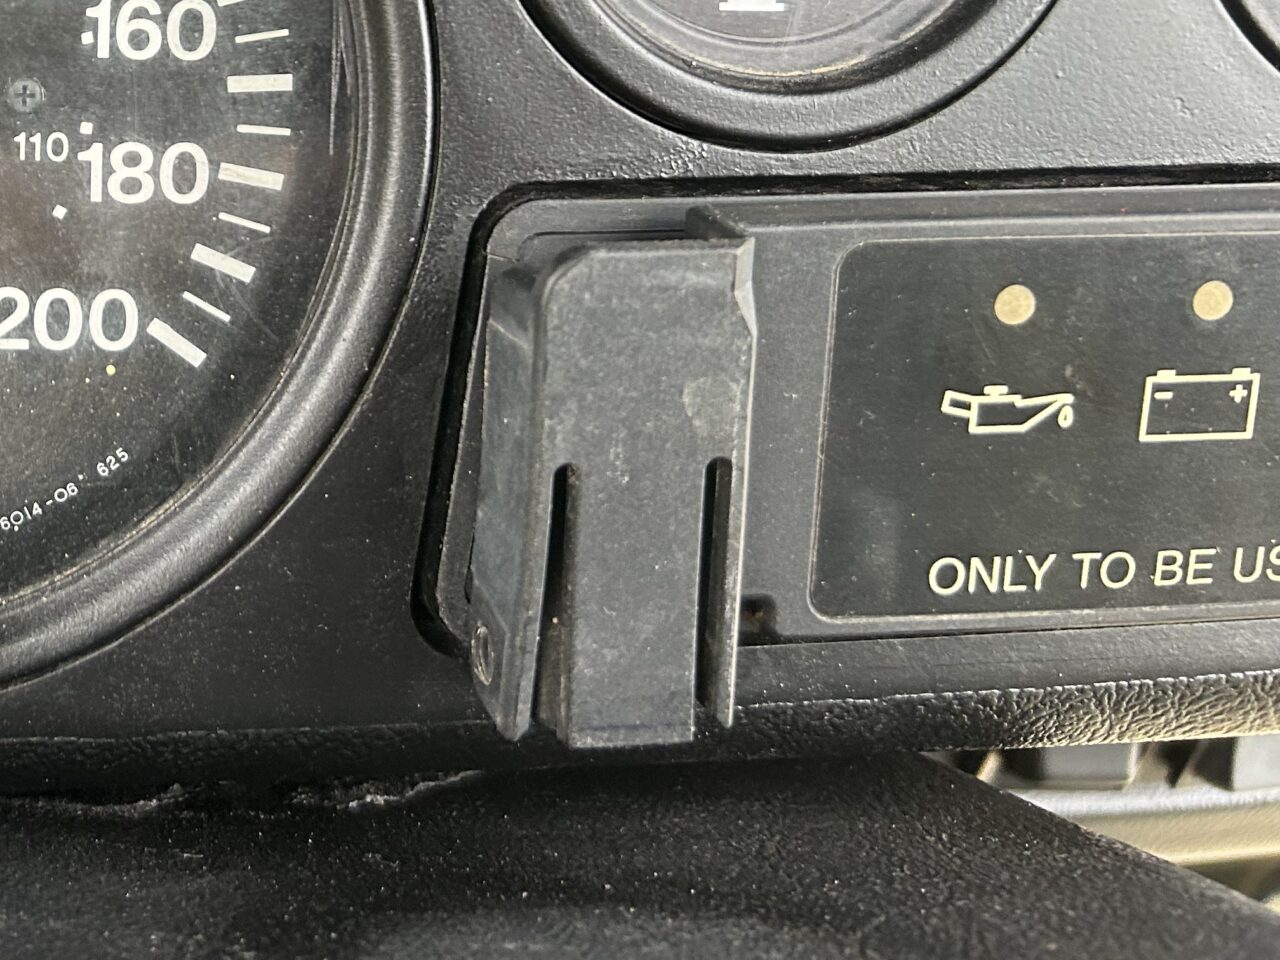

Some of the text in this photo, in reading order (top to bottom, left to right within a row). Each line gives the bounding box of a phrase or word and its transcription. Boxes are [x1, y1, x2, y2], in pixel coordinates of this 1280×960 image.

[14, 132, 69, 162] 110
[77, 141, 209, 204] 180
[96, 447, 129, 476] 625
[928, 553, 1057, 595] ONLY
[1072, 551, 1136, 588] TO
[1153, 548, 1217, 586] BE
